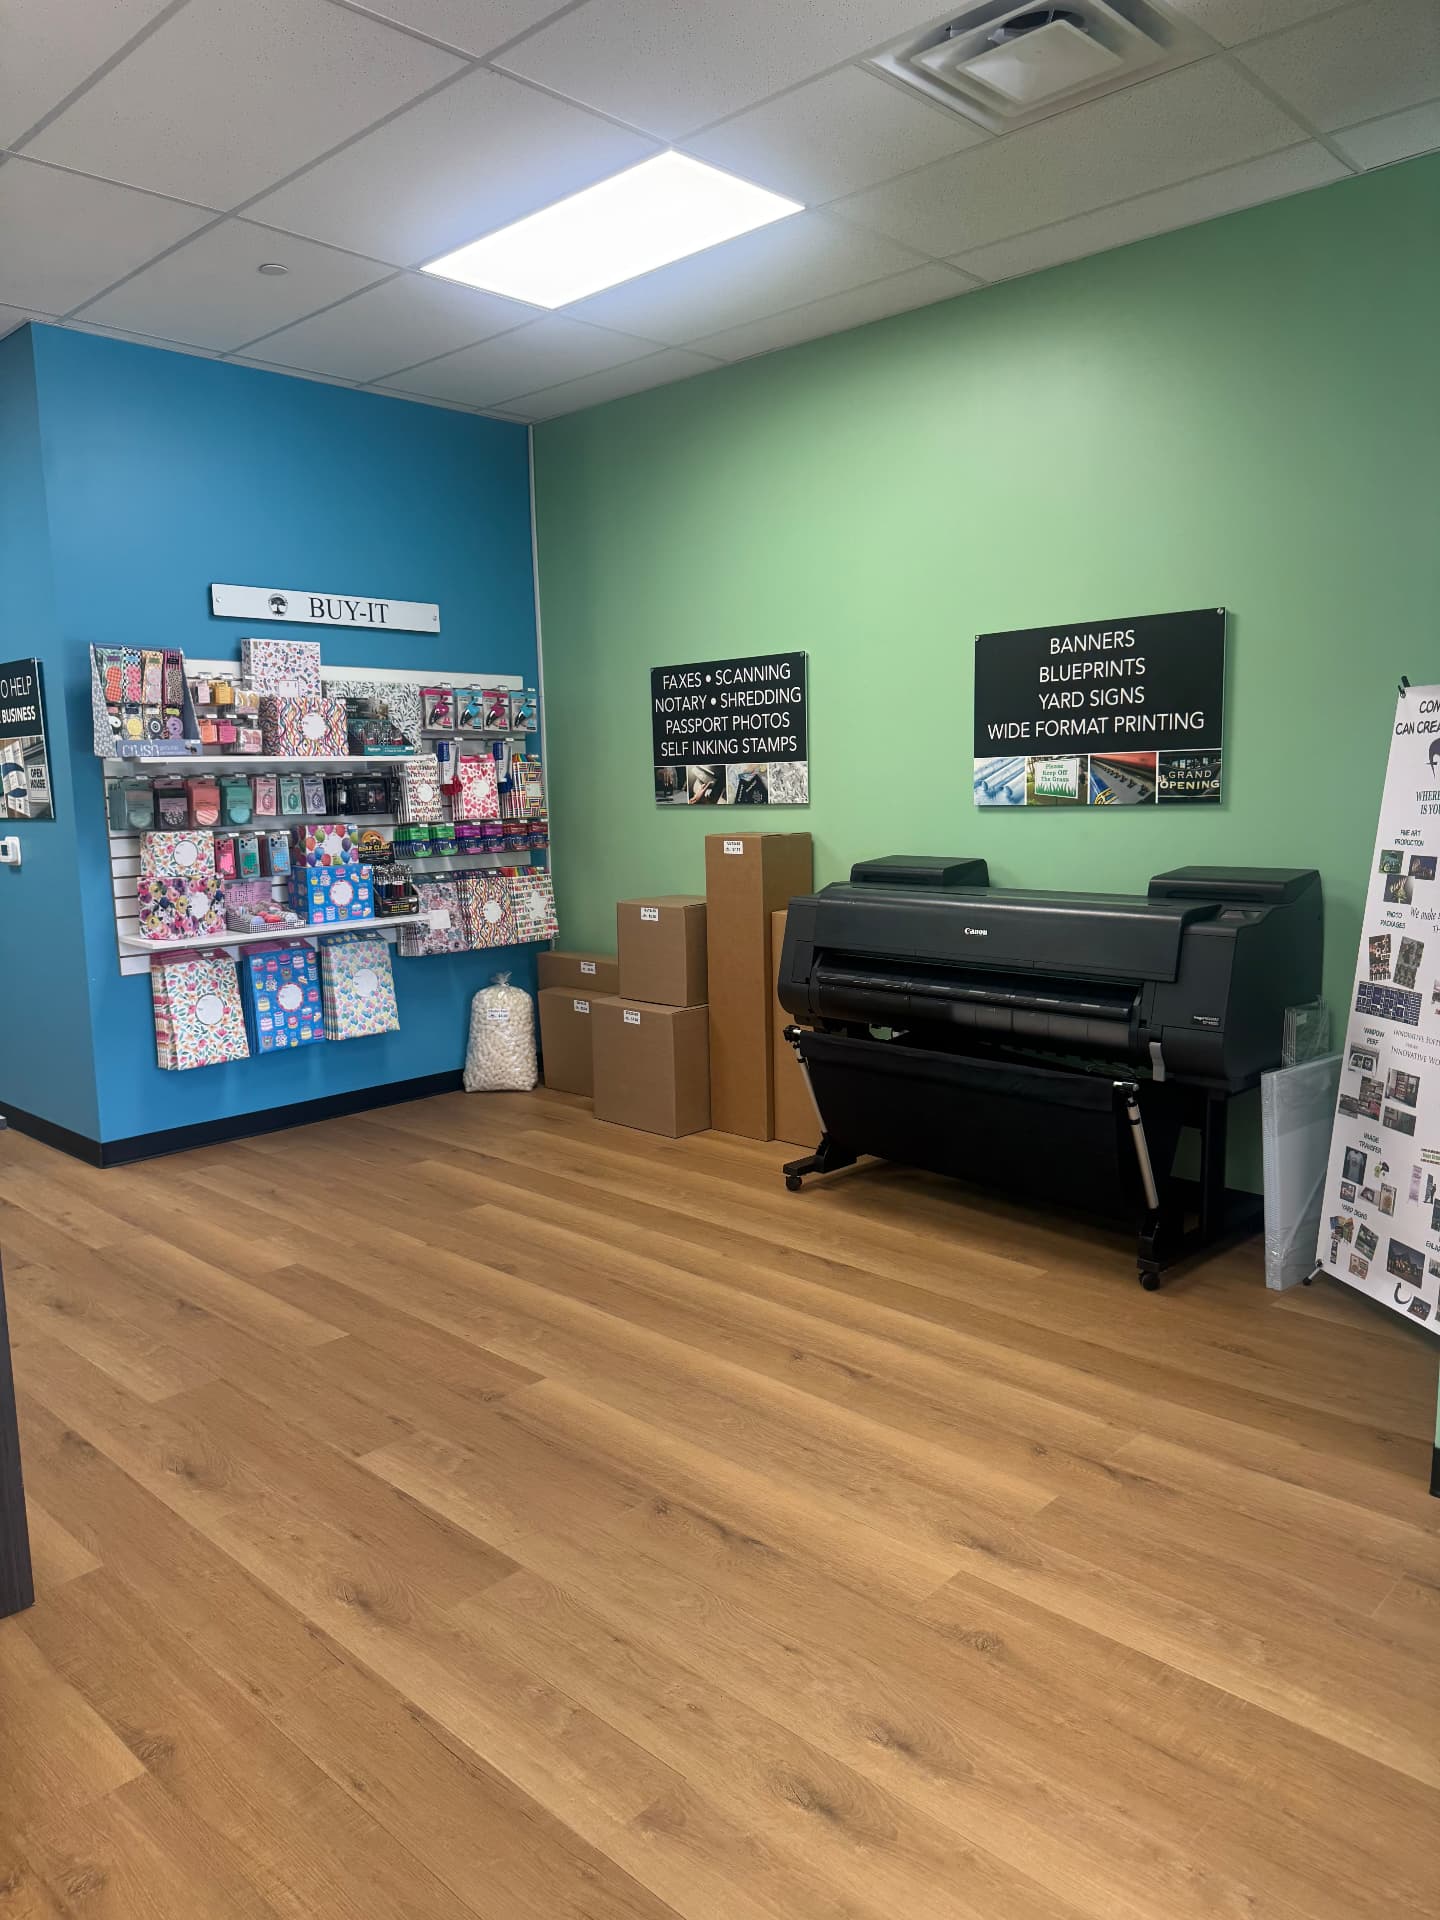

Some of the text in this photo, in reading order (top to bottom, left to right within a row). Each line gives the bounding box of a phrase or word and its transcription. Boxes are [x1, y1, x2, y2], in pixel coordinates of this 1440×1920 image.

[308, 597, 388, 623] BUY-IT
[1050, 629, 1135, 655] BANNERS
[663, 663, 791, 690] FAXES SCANNING
[1039, 657, 1146, 683] BLUEPRINTS
[10, 675, 32, 697] HELP
[655, 686, 801, 712] NOTARY SHREDDING
[1038, 686, 1145, 710] YARD SIGNS
[2, 705, 36, 724] BUSINESS
[666, 711, 790, 735] PASSPORT PHOTOS
[987, 711, 1204, 740] WIDE FORMAT PRINTING
[1395, 722, 1414, 735] CAN
[661, 735, 797, 757] SELF INKING STAMPS
[1160, 779, 1220, 790] OPENING
[1168, 770, 1212, 779] GRAND
[964, 927, 988, 936] Canon
[1391, 1045, 1427, 1062] INNOVATIVE
